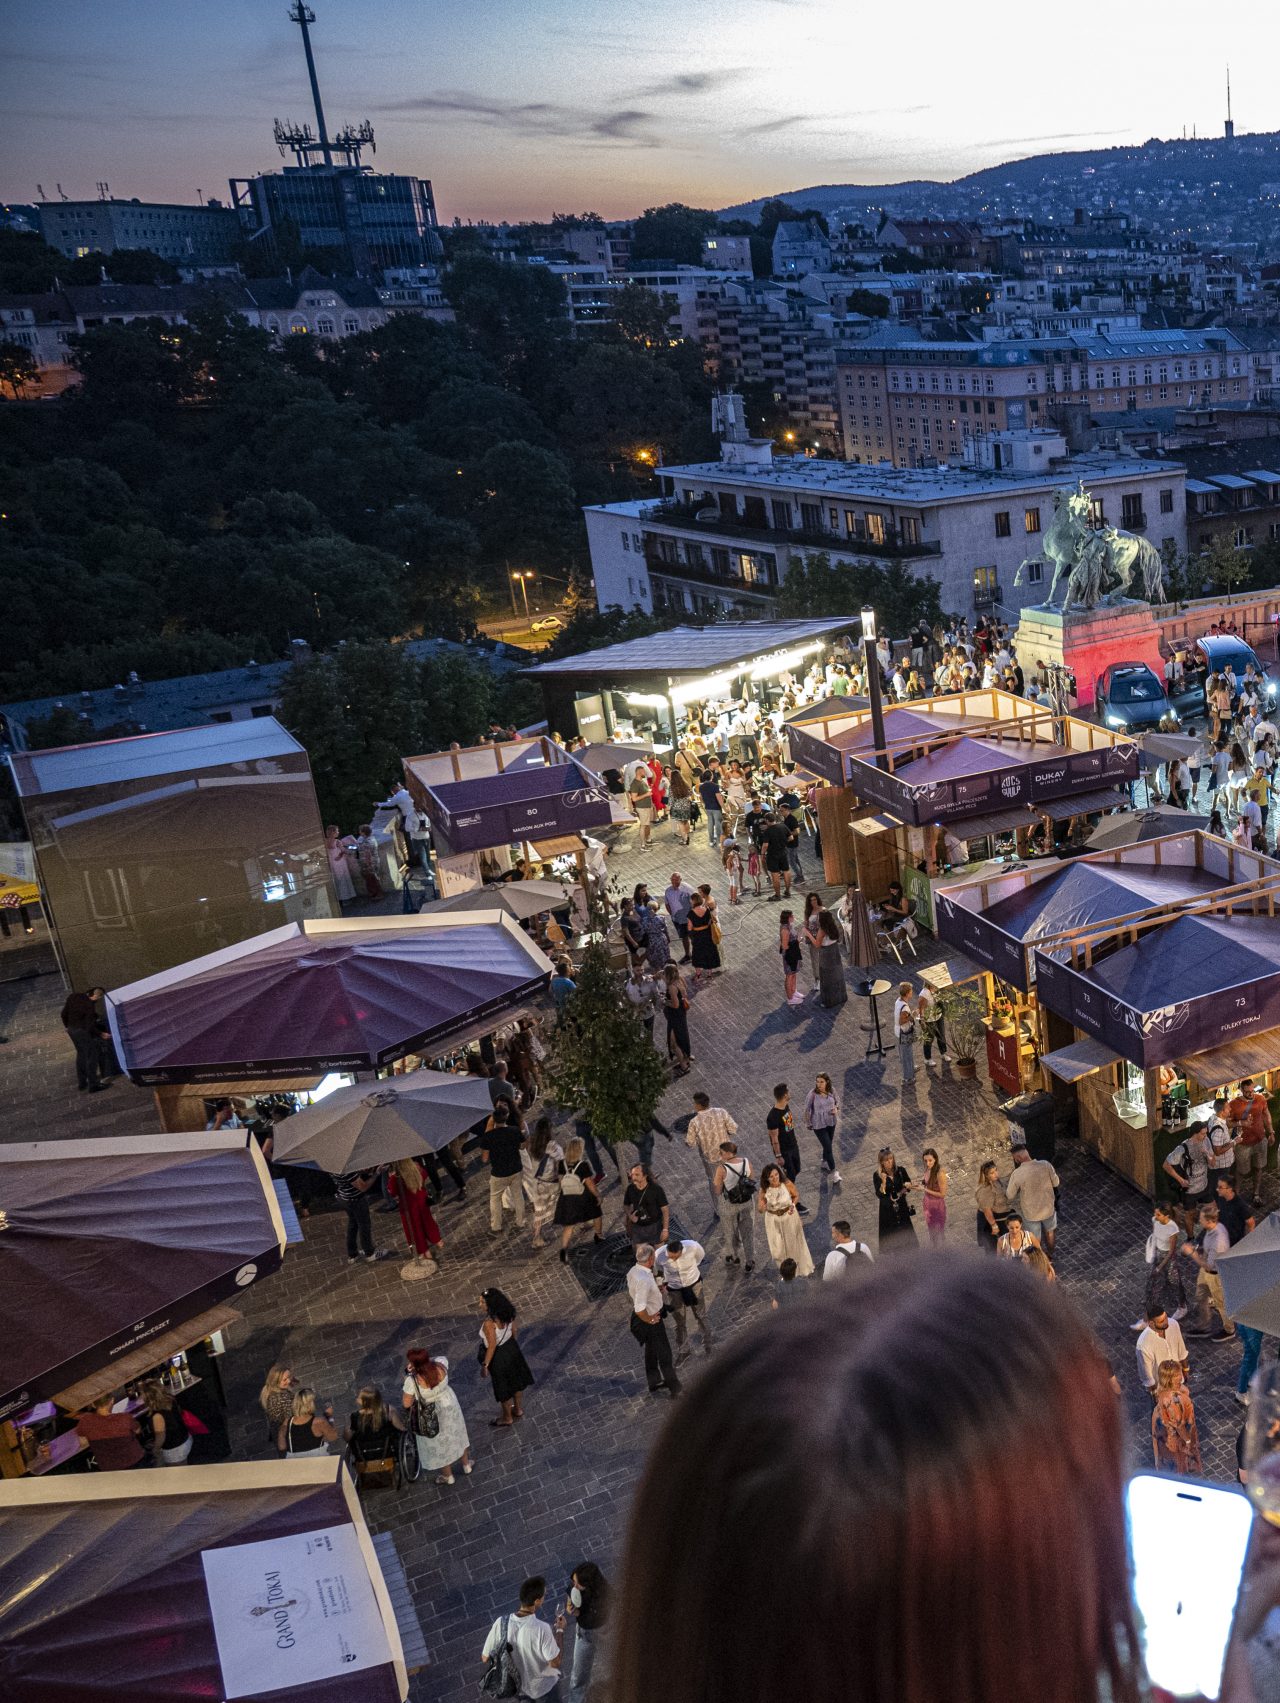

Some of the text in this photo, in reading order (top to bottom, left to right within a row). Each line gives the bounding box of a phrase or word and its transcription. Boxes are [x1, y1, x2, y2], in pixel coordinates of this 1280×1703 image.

[1001, 775, 1021, 788] KUCS
[1035, 769, 1066, 782] DUKAY
[1040, 778, 1062, 786] WINERY
[526, 808, 538, 816] 80
[512, 820, 557, 833] MAISON AUX POIS
[1083, 992, 1091, 1003] 73
[1235, 997, 1246, 1007] 73
[1220, 1014, 1261, 1032] FÜLEKY TOKAJ
[998, 1039, 1006, 1060] H
[133, 1321, 145, 1332] 82
[273, 1609, 296, 1650] GRAND
